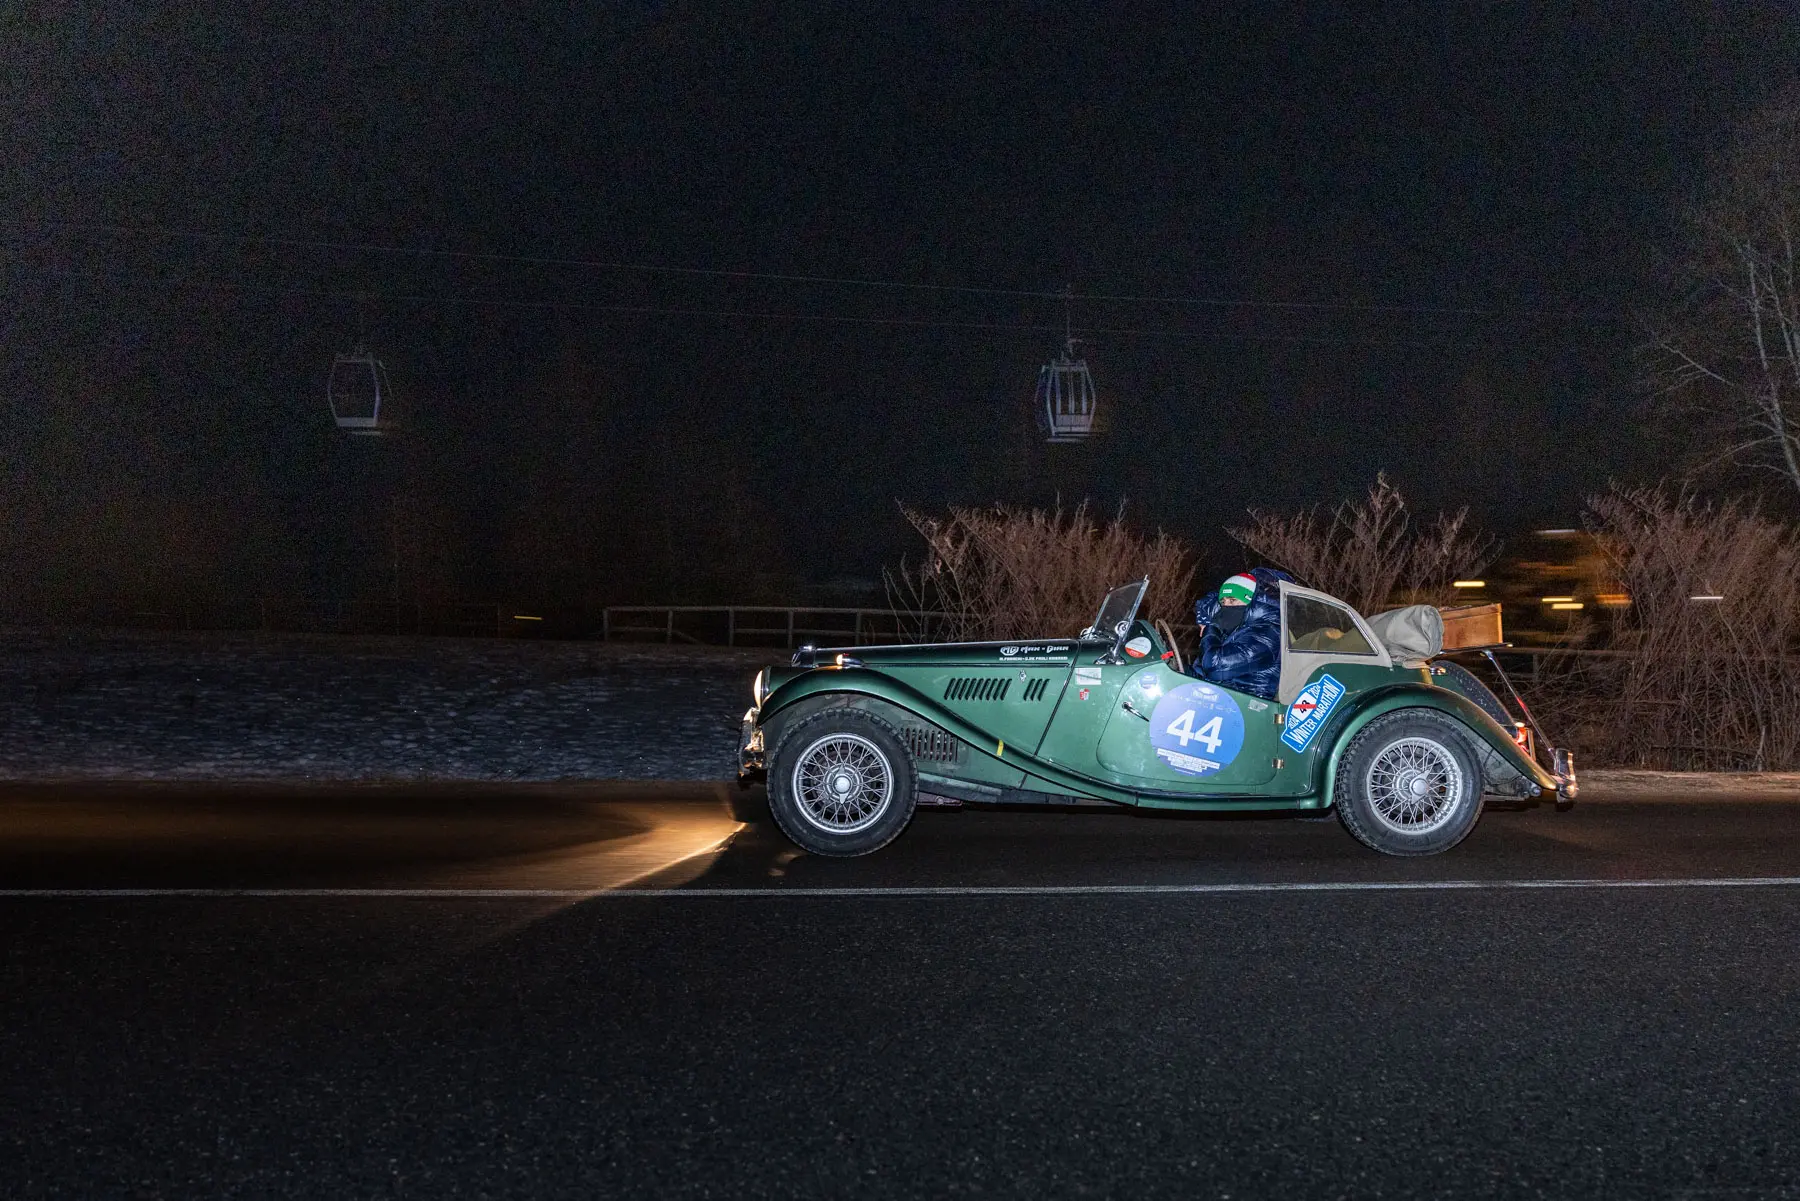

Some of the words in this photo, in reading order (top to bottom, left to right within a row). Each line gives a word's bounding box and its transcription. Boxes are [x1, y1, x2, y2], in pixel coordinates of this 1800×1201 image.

[1000, 646, 1019, 656] MG
[1166, 709, 1223, 754] 44
[1285, 718, 1317, 745] WINTER
[1312, 678, 1341, 721] MARATHON
